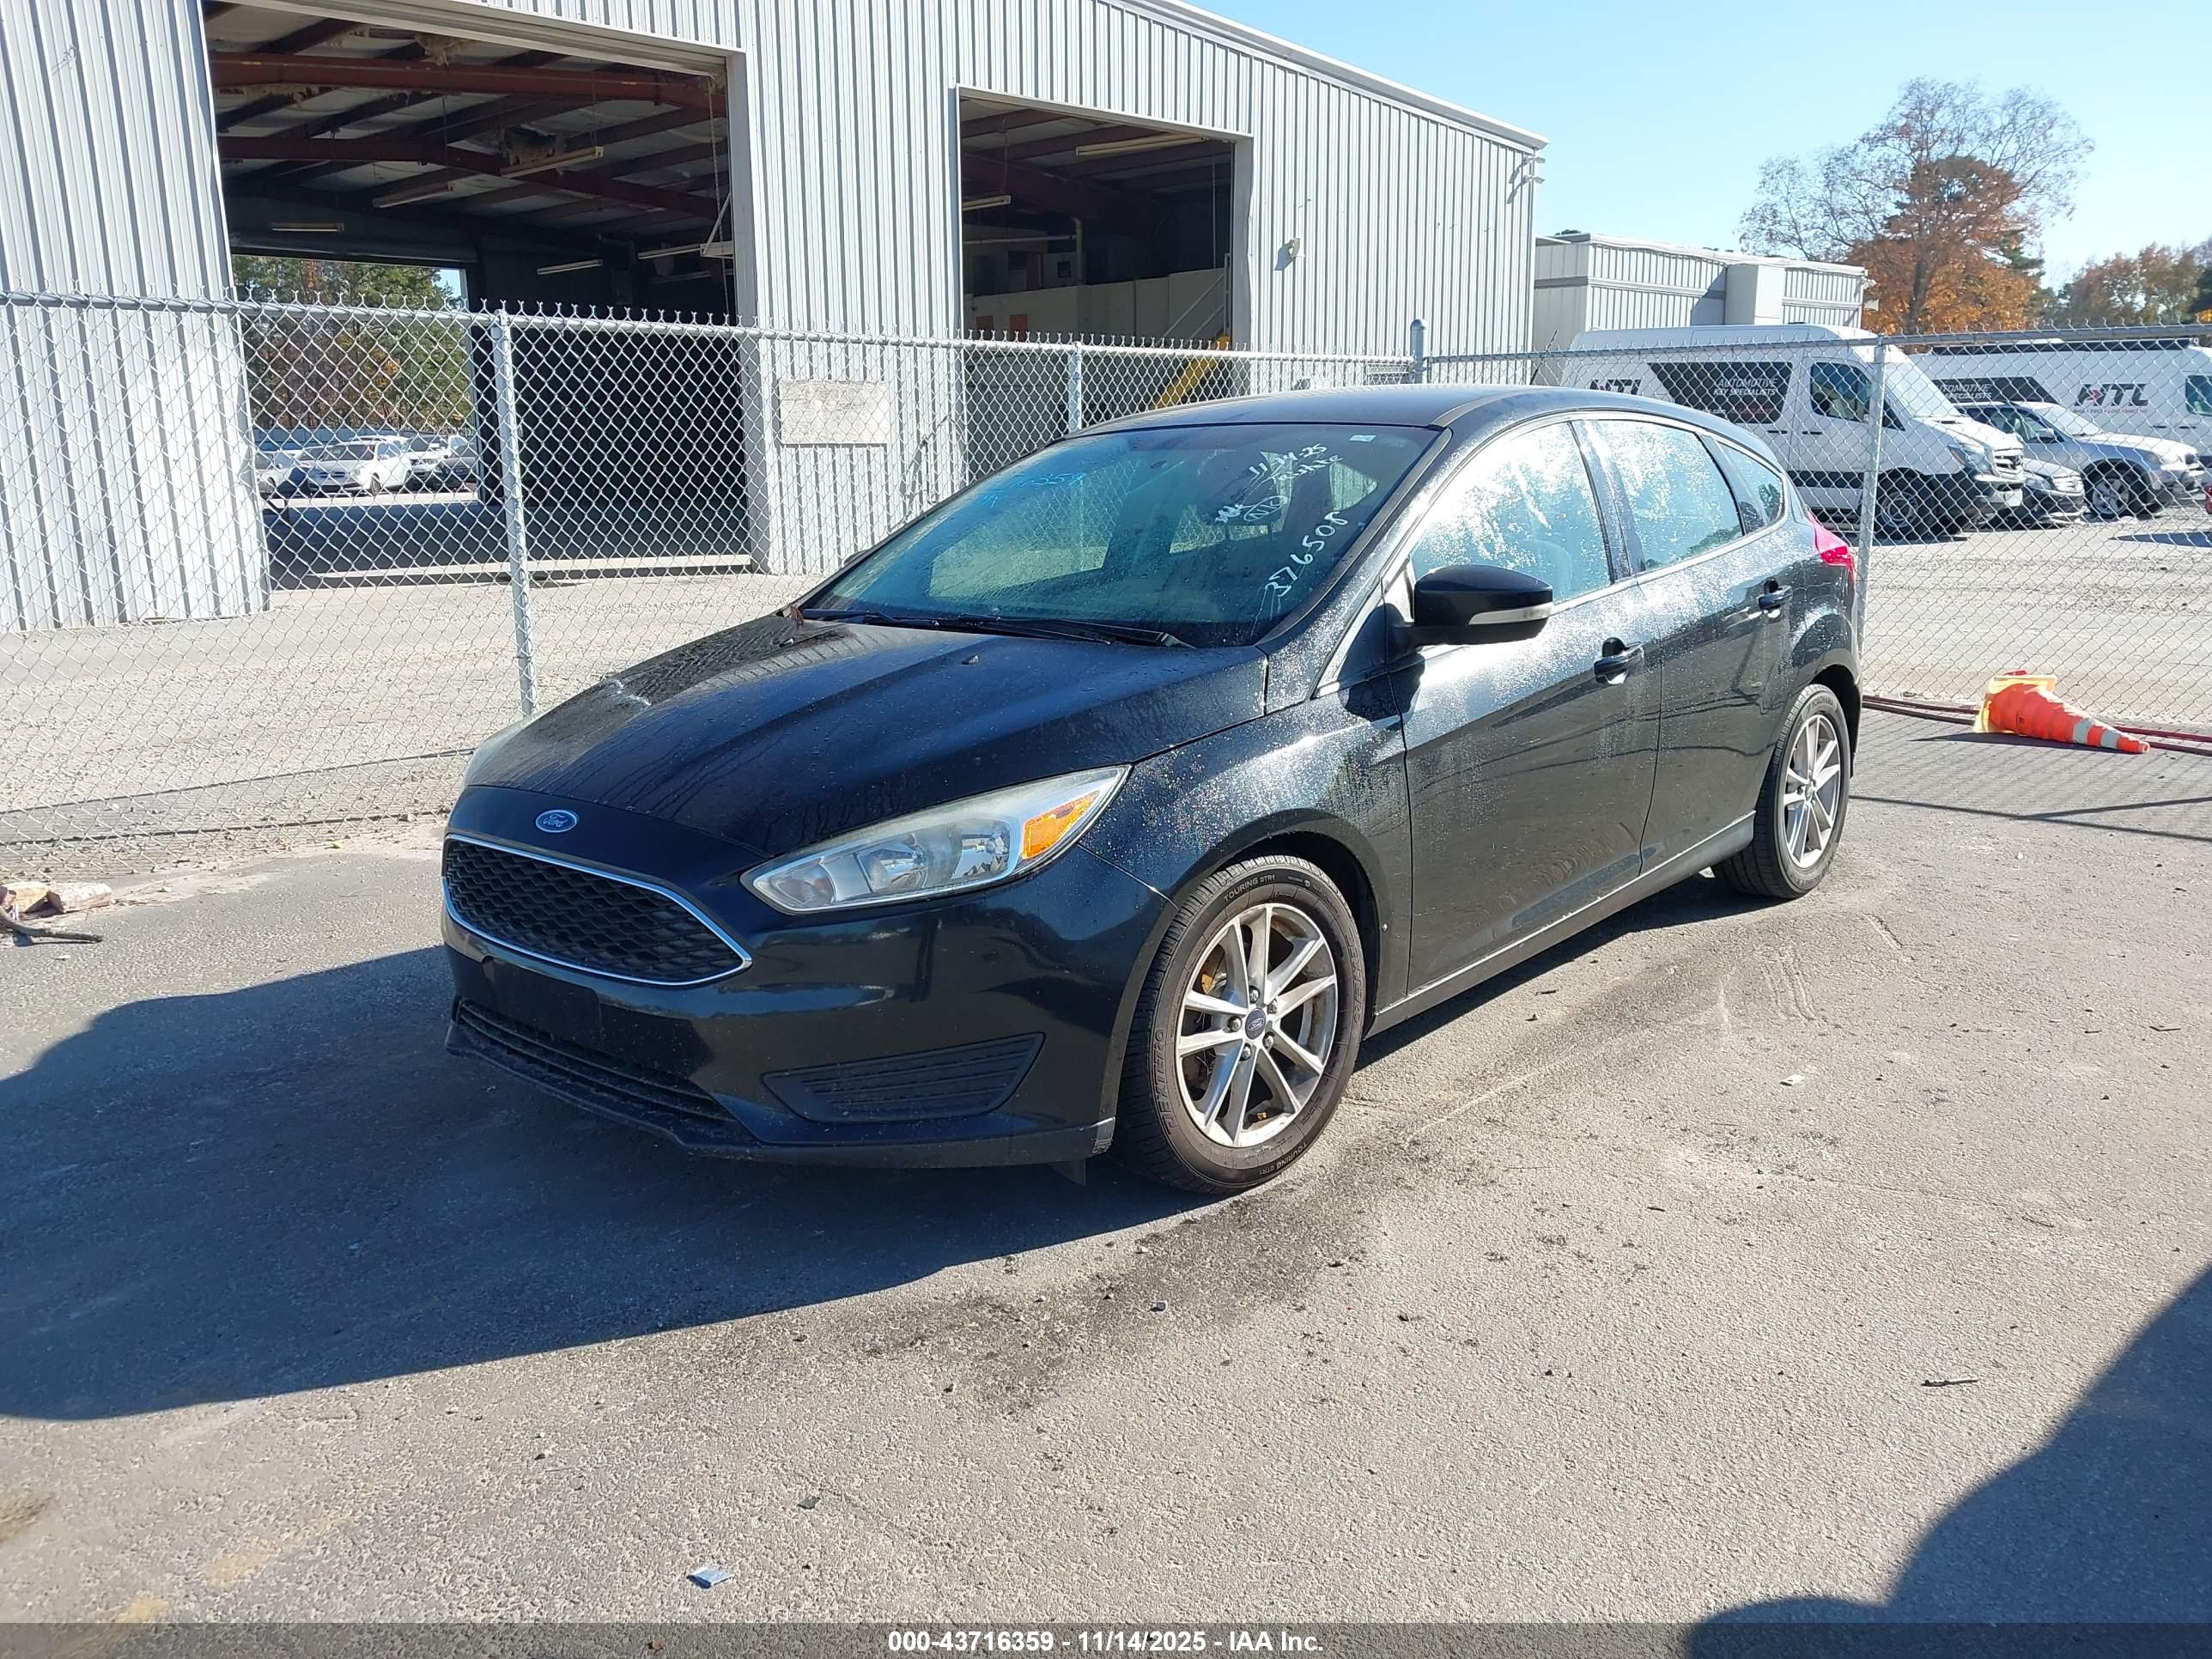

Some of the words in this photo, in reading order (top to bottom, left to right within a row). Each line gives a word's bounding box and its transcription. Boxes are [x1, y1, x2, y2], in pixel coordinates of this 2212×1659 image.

[1717, 378, 1778, 387] AUTOMOTIVE
[1936, 383, 1992, 392] UTOMOTIVE
[1223, 877, 1259, 902] TOURING
[1276, 1141, 1308, 1167] TOURING
